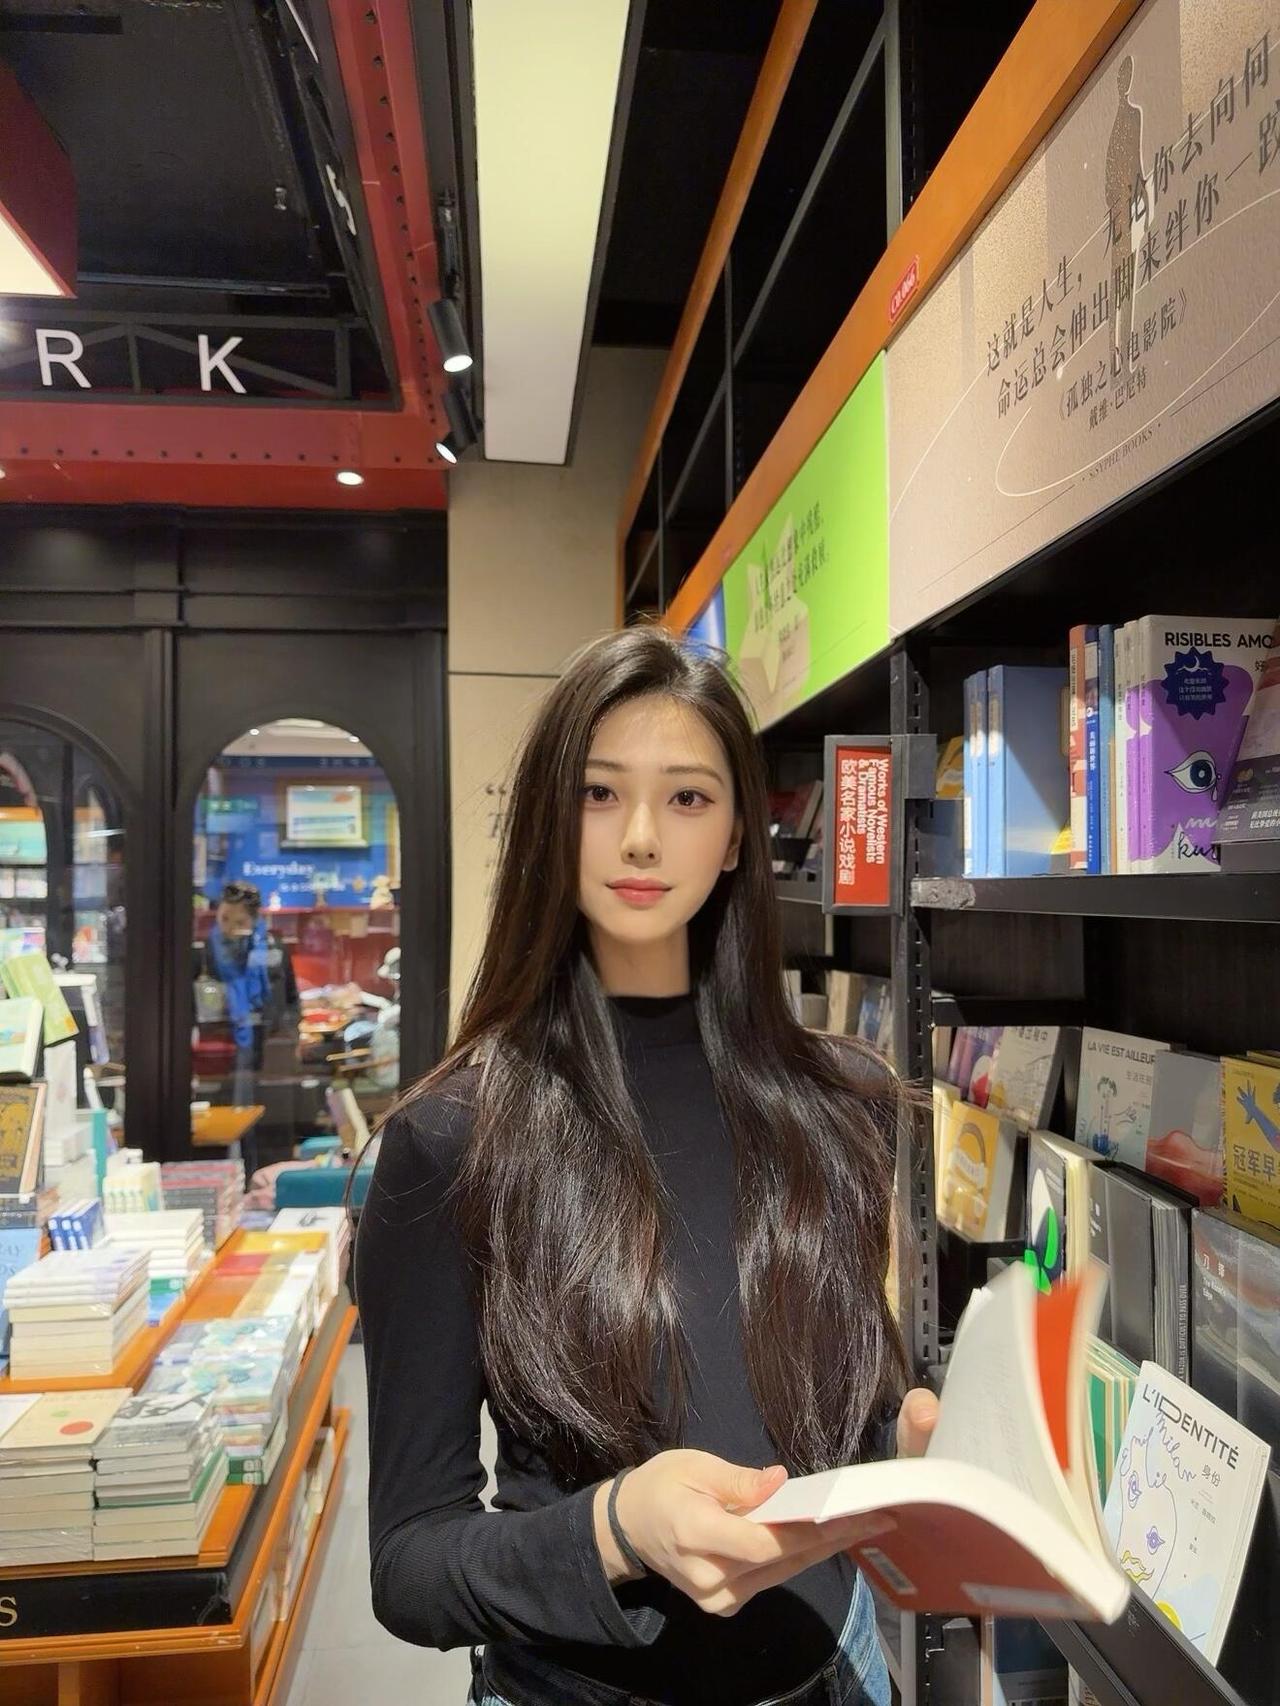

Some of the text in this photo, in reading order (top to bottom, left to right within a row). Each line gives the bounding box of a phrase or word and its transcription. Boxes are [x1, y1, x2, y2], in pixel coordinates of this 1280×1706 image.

[1164, 632, 1231, 648] RISIBLES
[839, 758, 858, 885] 欧美名家小说戏剧
[857, 759, 869, 834] & Dramatists
[866, 759, 878, 863] Famous Novelists
[876, 759, 889, 864] Works of Western
[1087, 1041, 1097, 1050] LA
[1098, 1043, 1110, 1054] VIE
[1111, 1046, 1124, 1057] EST
[1233, 1144, 1280, 1182] 冠军早
[1201, 1464, 1220, 1487] 身份
